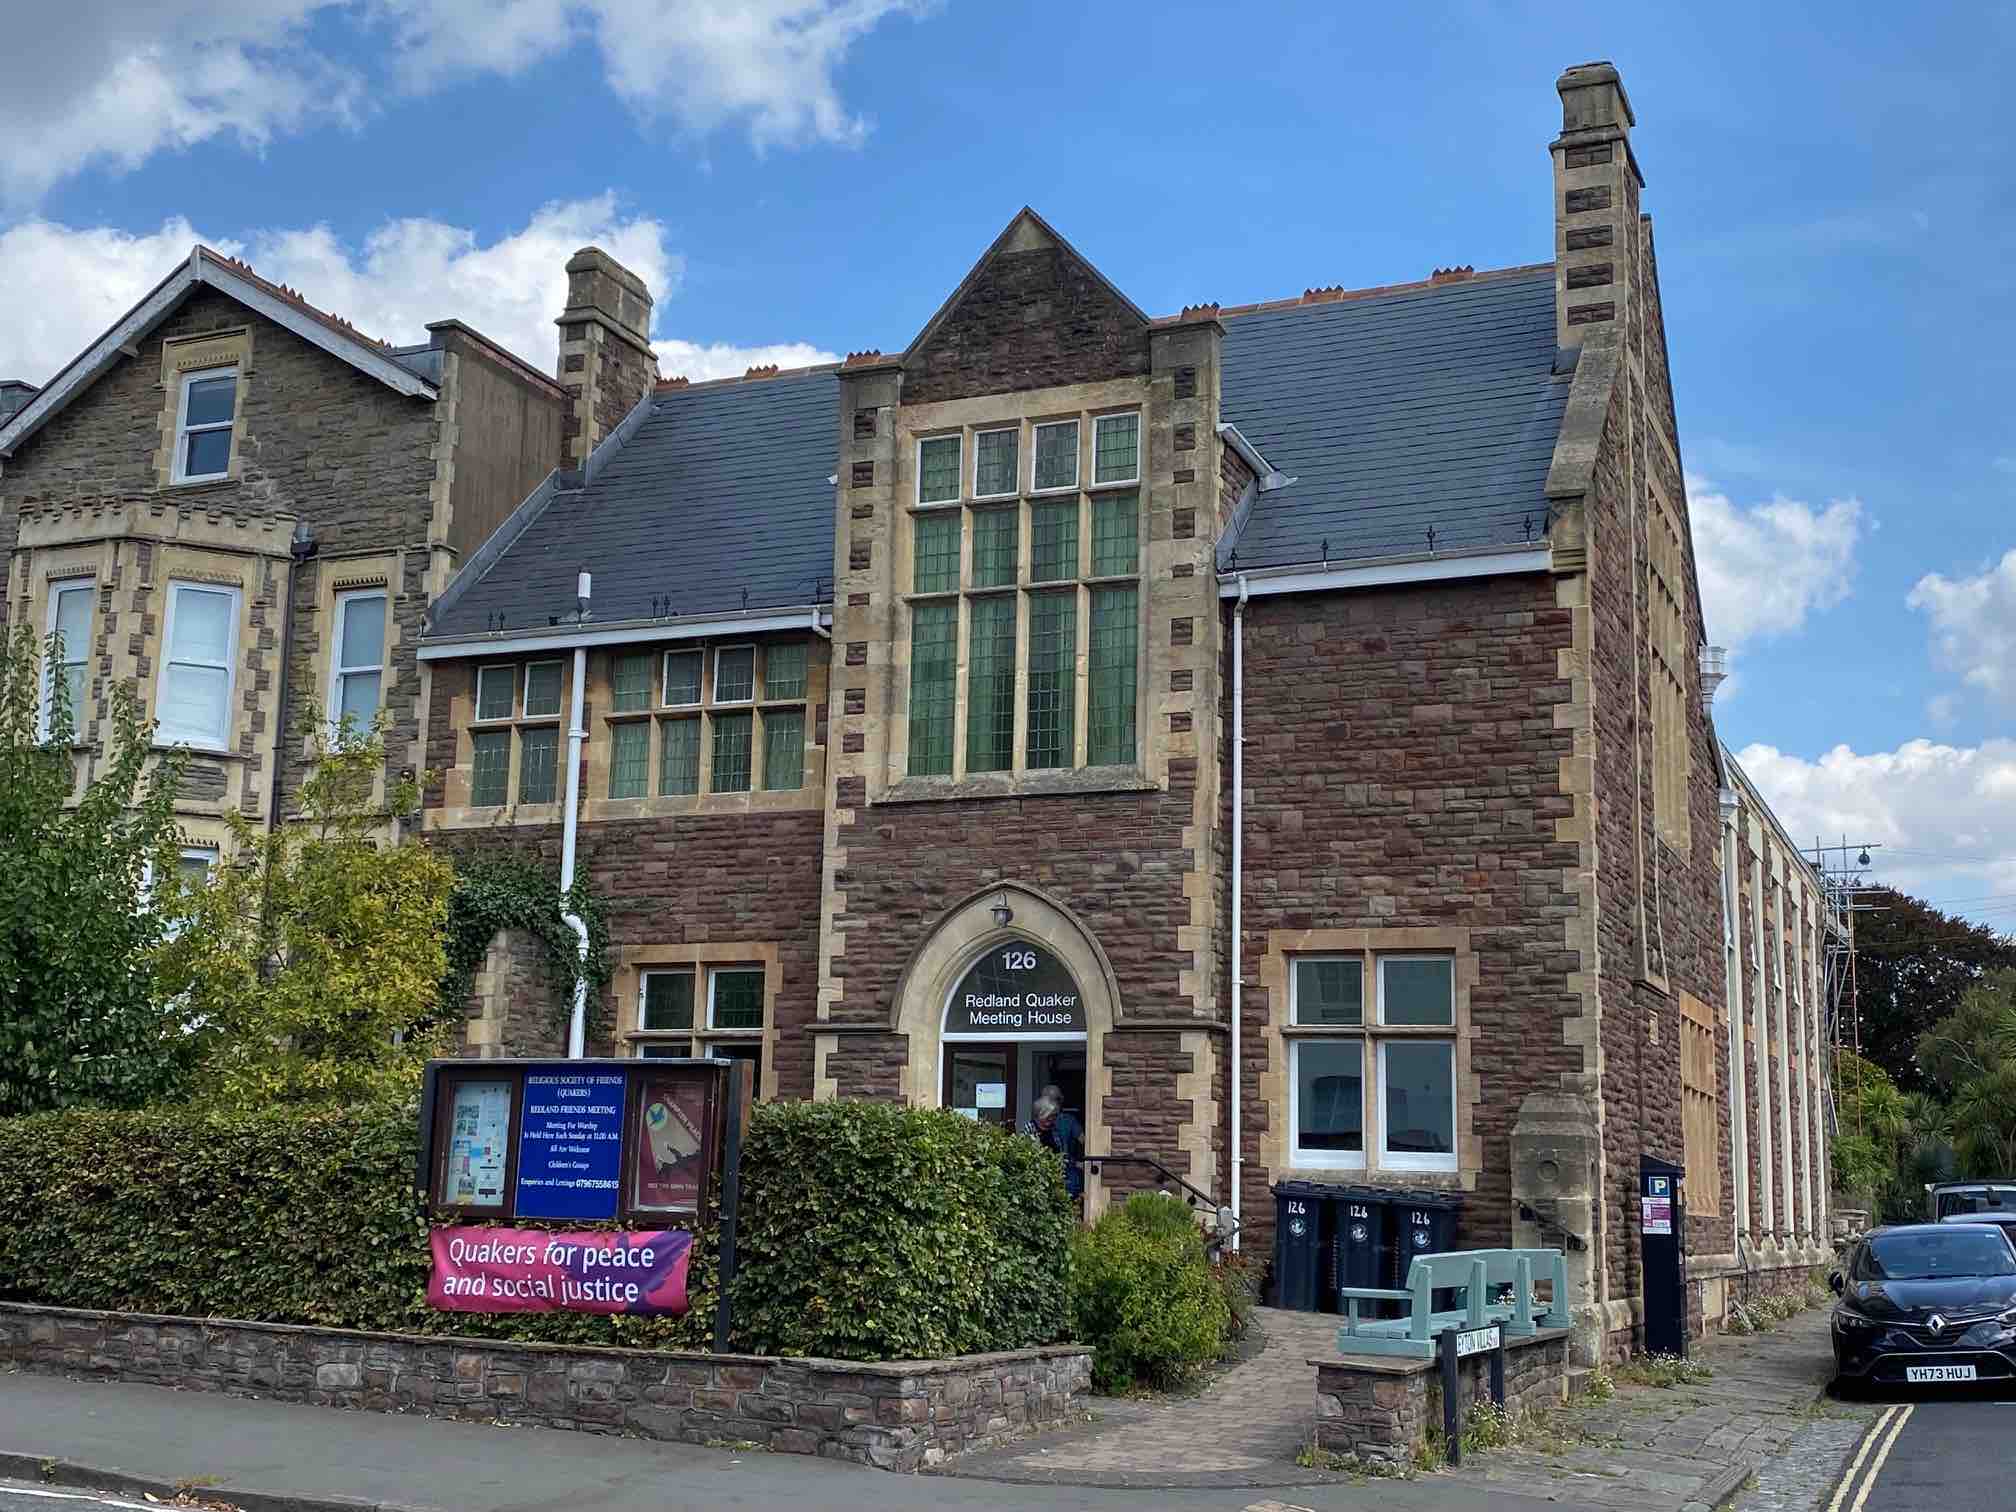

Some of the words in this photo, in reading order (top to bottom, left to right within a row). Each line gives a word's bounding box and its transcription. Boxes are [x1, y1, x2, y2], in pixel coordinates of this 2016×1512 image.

[1002, 951, 1036, 970] 126
[965, 994, 1020, 1008] Redland
[1025, 993, 1077, 1007] Quaker
[969, 1011, 1022, 1027] Meeting
[1028, 1011, 1072, 1024] House
[528, 1076, 559, 1085] RELIGIOUS
[560, 1076, 585, 1085] SOCIETY
[586, 1076, 596, 1085] OF
[596, 1076, 623, 1085] FRIENDS
[557, 1088, 591, 1098] (QUAKERS)
[530, 1105, 560, 1114] REDLAND
[560, 1105, 586, 1114] FRIENDS
[587, 1105, 616, 1114] MEETING
[1655, 1180, 1666, 1193] P
[1287, 1200, 1306, 1214] 126
[1350, 1204, 1368, 1219] 126
[1411, 1211, 1430, 1225] 126
[449, 1238, 537, 1267] Quakers
[543, 1241, 578, 1266] for
[583, 1246, 655, 1273] peace
[443, 1272, 486, 1297] and
[492, 1274, 554, 1298] social
[561, 1275, 639, 1305] justice
[1911, 1368, 1944, 1380] YH73
[1946, 1367, 1971, 1379] HUJ
